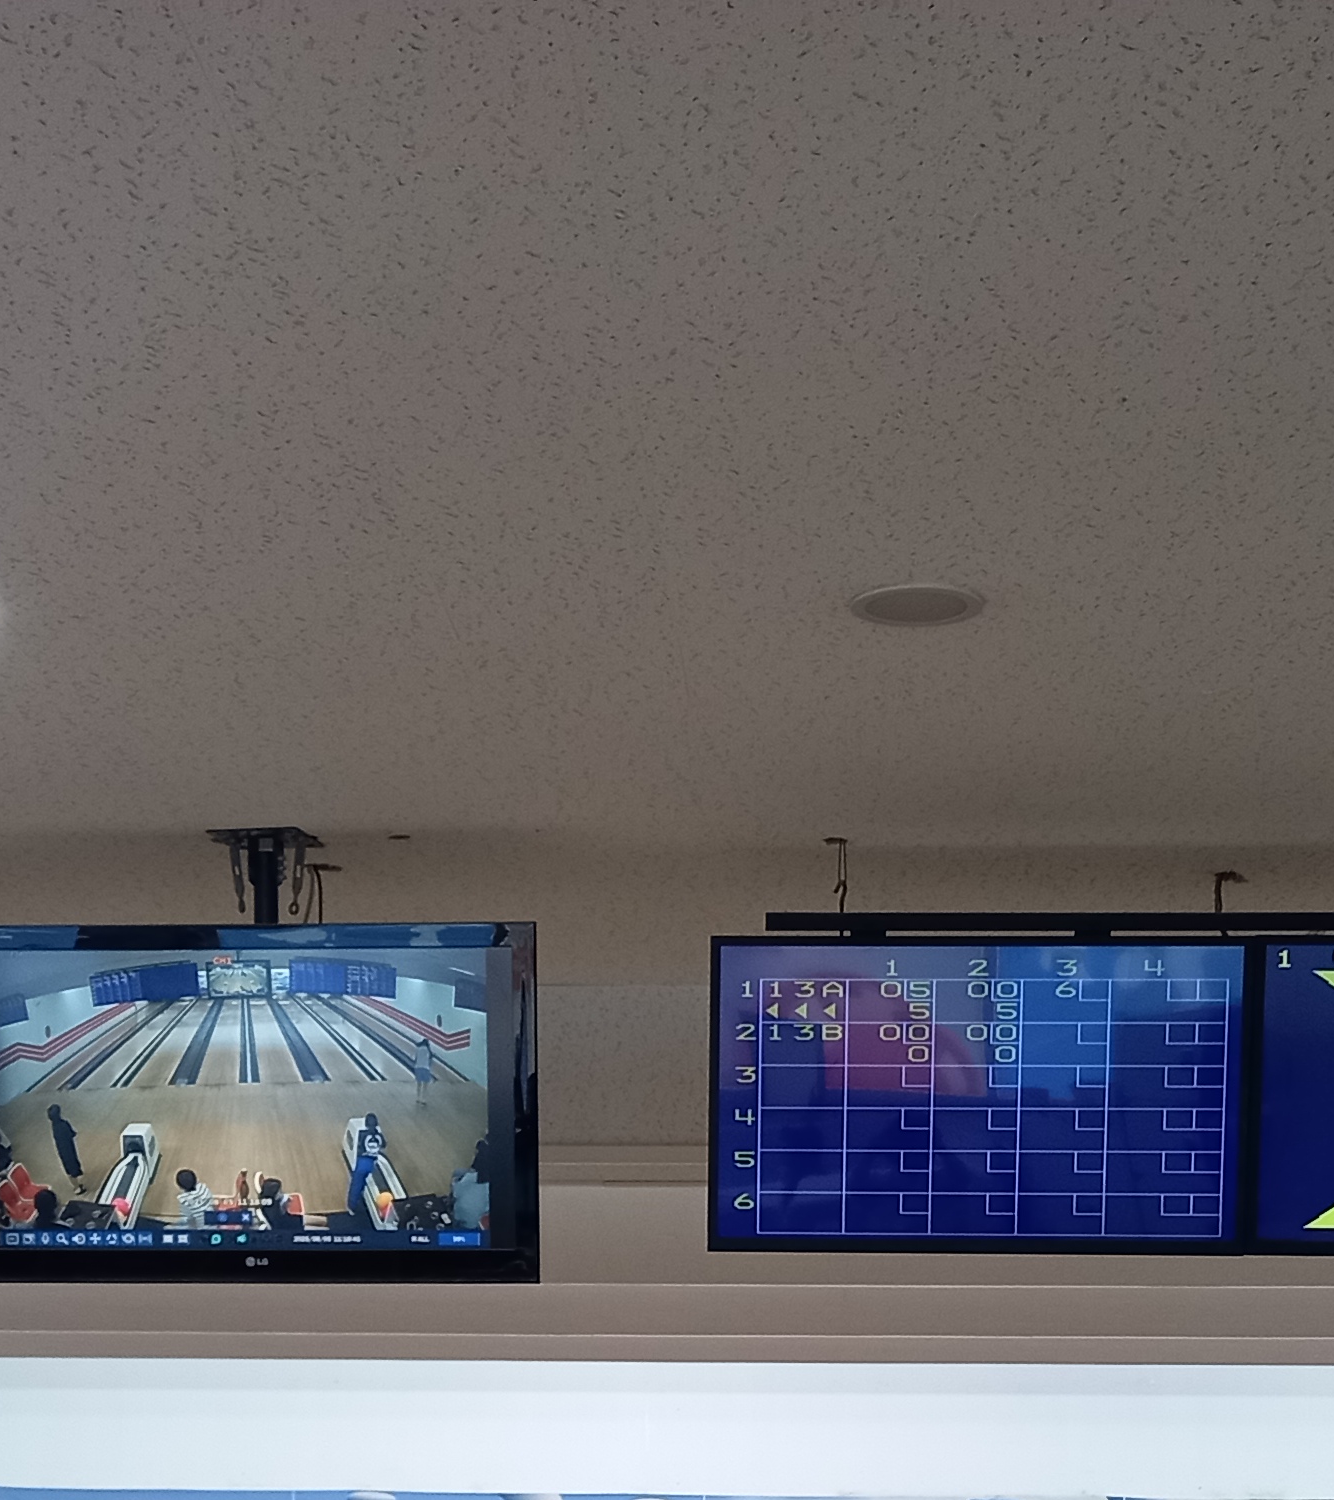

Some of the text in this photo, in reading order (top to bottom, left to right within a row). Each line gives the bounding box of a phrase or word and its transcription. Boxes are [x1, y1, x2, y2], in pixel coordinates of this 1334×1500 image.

[884, 958, 1167, 977] 1 2 3 4
[1278, 949, 1292, 969] 1
[740, 980, 755, 998] 1
[1053, 980, 1078, 999] 6
[908, 1002, 1018, 1020] 5 5
[734, 1023, 758, 1042] 2
[907, 1045, 1017, 1063] 0 0
[734, 1066, 758, 1085] 3
[732, 1109, 757, 1127] 4
[732, 1150, 756, 1169] 5
[732, 1193, 756, 1211] 6
